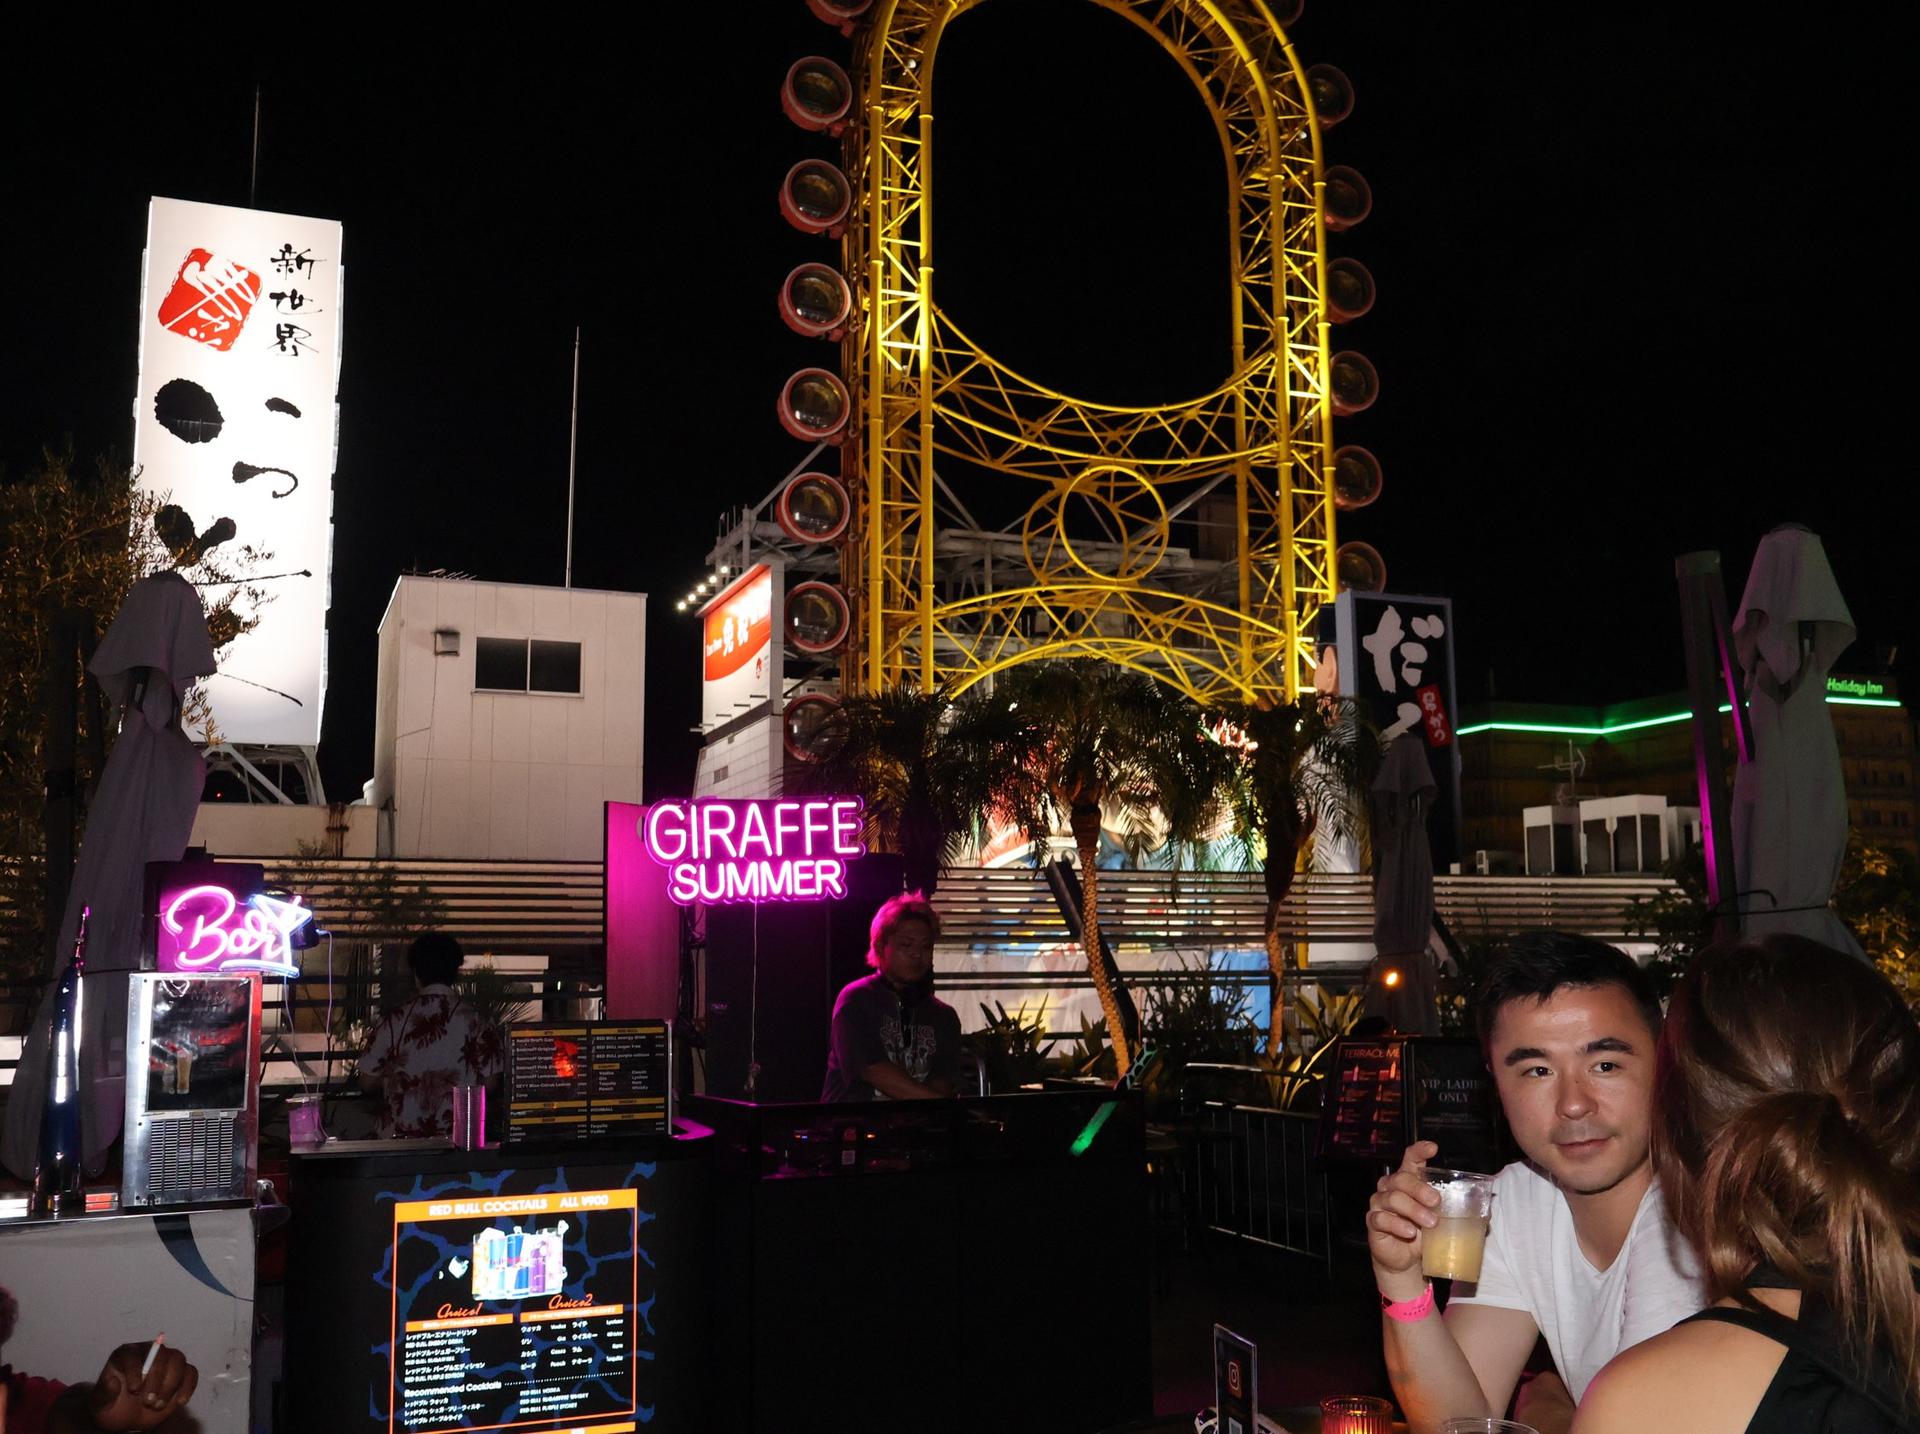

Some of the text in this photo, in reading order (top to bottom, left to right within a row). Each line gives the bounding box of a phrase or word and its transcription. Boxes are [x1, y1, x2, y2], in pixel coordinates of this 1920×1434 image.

[265, 243, 327, 357] 新世界
[1827, 677, 1883, 696] Holiday Inn
[650, 802, 860, 860] GIRAFFE
[673, 859, 843, 900] SUMMER
[165, 885, 279, 967] Bar
[1344, 1047, 1401, 1058] TERRACE ME
[1421, 1079, 1486, 1089] VIP LADIE
[1439, 1092, 1469, 1104] ONLY
[428, 1205, 452, 1217] RED
[455, 1203, 481, 1215] BULL
[483, 1199, 548, 1213] COCKTAILS
[559, 1197, 579, 1208] ALL
[404, 1381, 502, 1398] Recommended Cocktails
